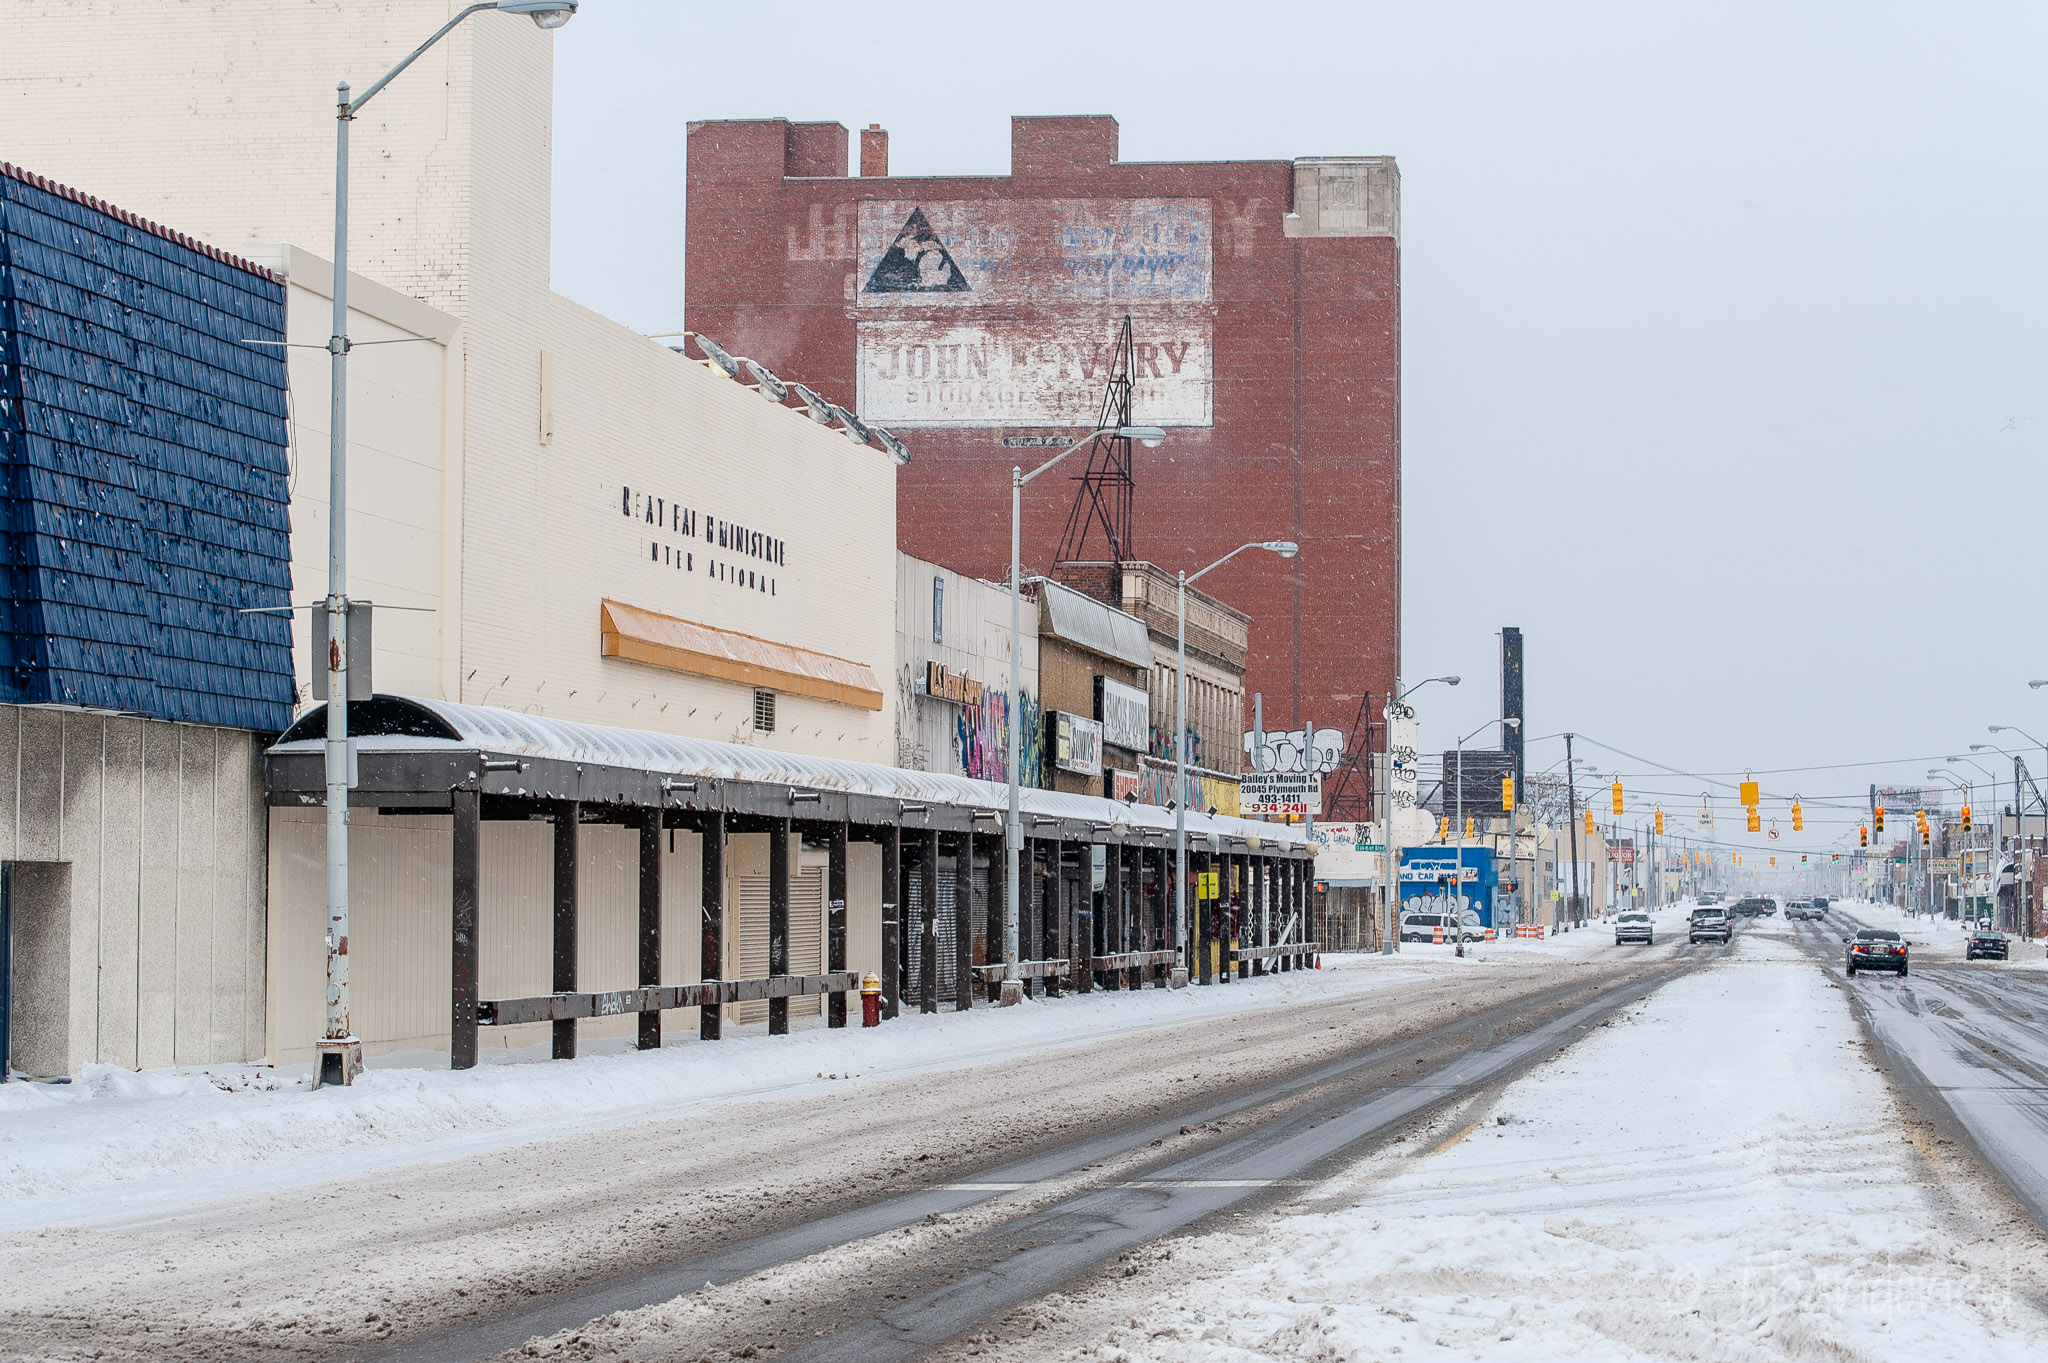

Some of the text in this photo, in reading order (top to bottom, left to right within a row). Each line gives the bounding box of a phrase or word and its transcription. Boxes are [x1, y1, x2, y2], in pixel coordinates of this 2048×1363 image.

[878, 343, 989, 380] JOHN
[1241, 774, 1275, 784] Bailey's
[1276, 773, 1307, 784] Moving
[1116, 775, 1138, 802] SHOES
[1241, 784, 1318, 794] 20045 Plymouth Rd
[1258, 794, 1301, 803] 493-1411
[1418, 872, 1434, 880] CAR
